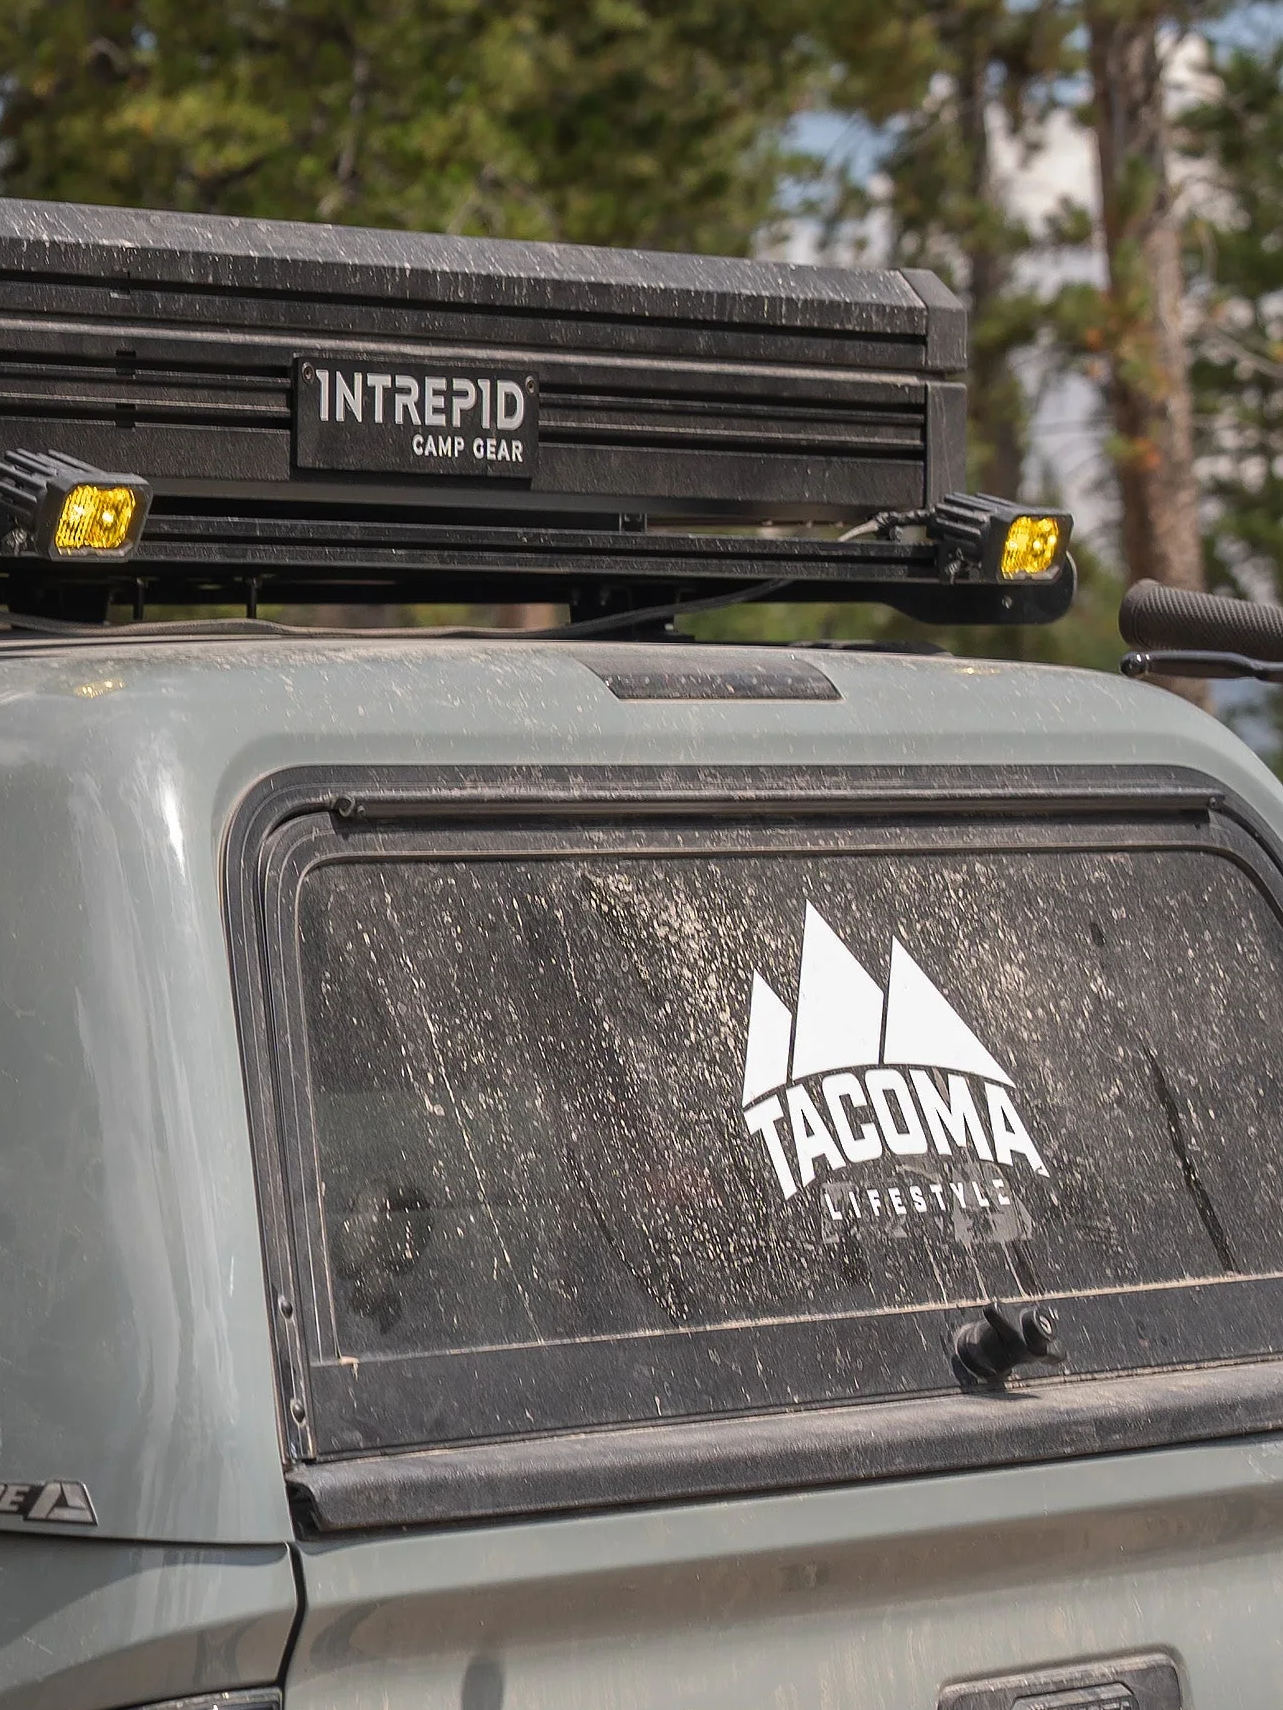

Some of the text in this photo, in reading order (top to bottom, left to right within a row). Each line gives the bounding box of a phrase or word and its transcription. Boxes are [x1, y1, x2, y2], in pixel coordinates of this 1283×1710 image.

[316, 369, 526, 431] INTREPID
[412, 434, 525, 462] CAMP GEAR
[743, 1068, 1051, 1201] TACOMA
[824, 1179, 1011, 1221] LIFESTYLE
